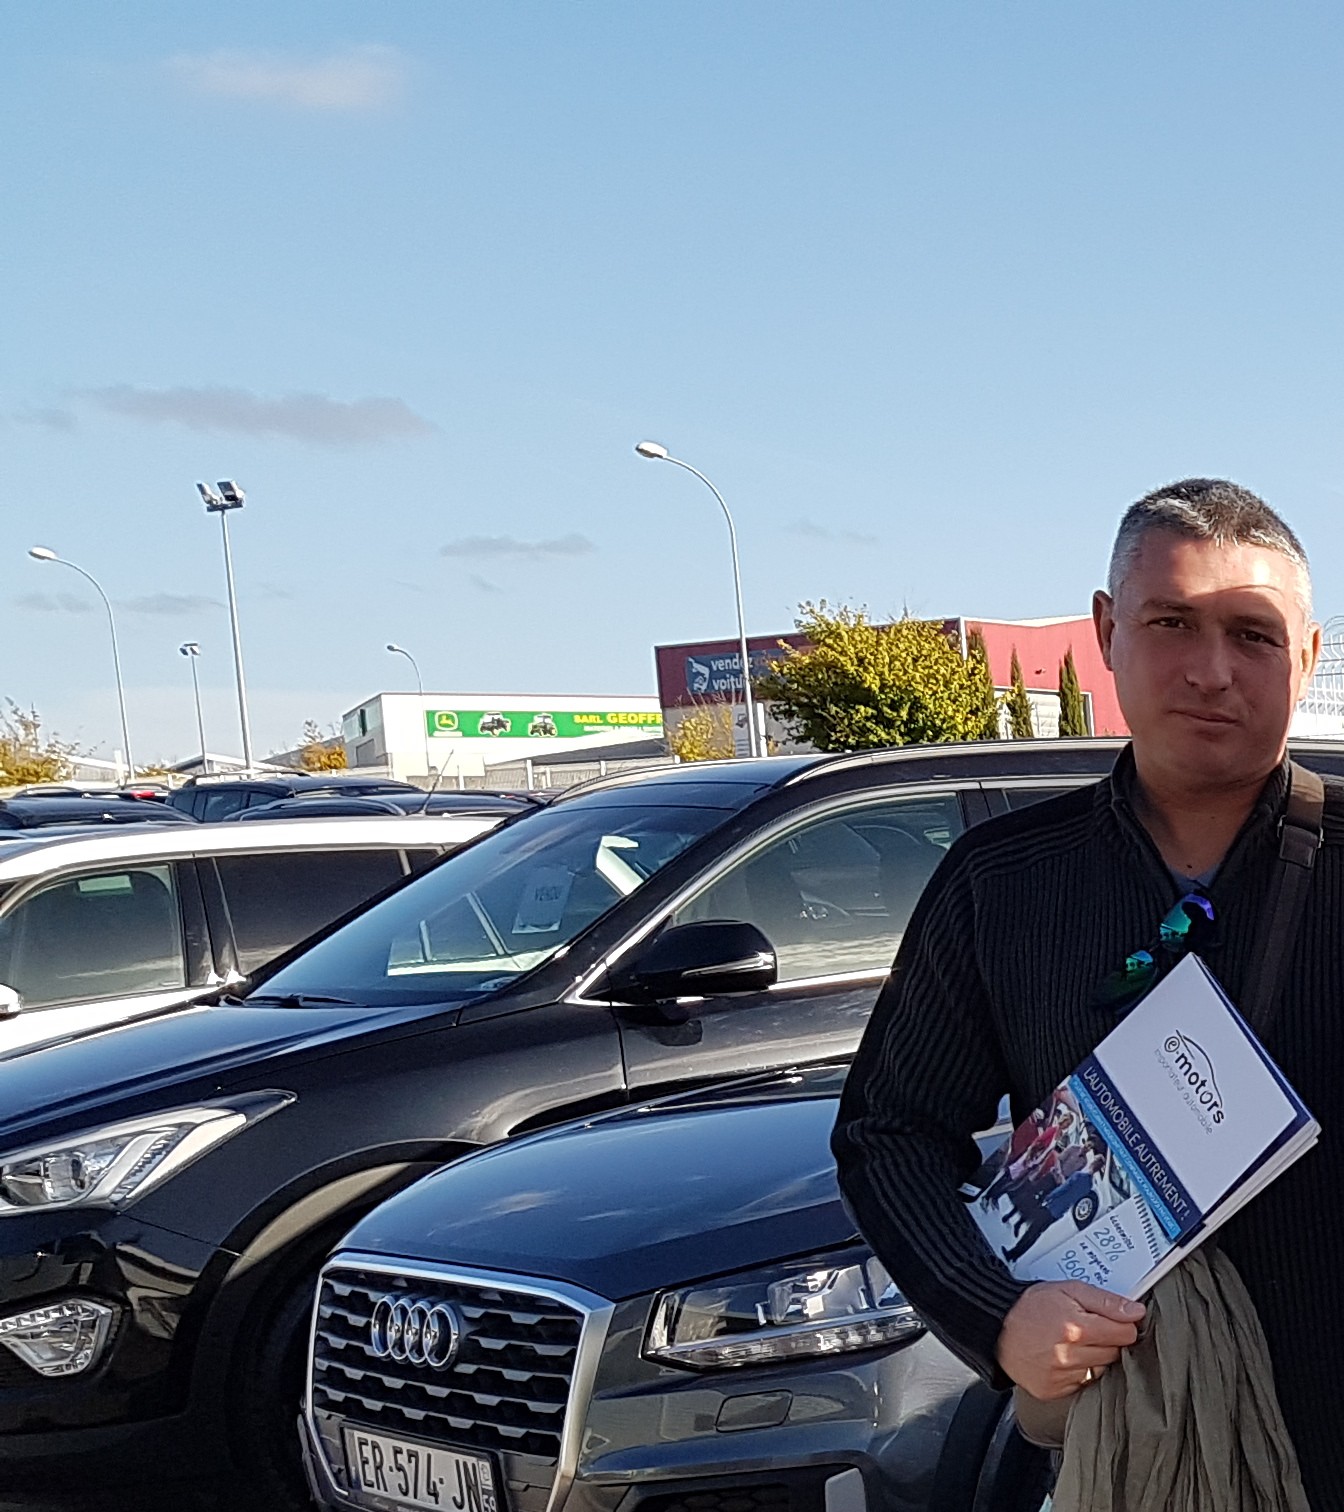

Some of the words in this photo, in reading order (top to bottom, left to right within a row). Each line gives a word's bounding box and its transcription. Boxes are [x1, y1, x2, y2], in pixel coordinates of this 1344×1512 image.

[573, 714, 603, 723] SARL
[1083, 1066, 1142, 1148] L'AUTOMOBILE
[1093, 1227, 1126, 1262] 28%
